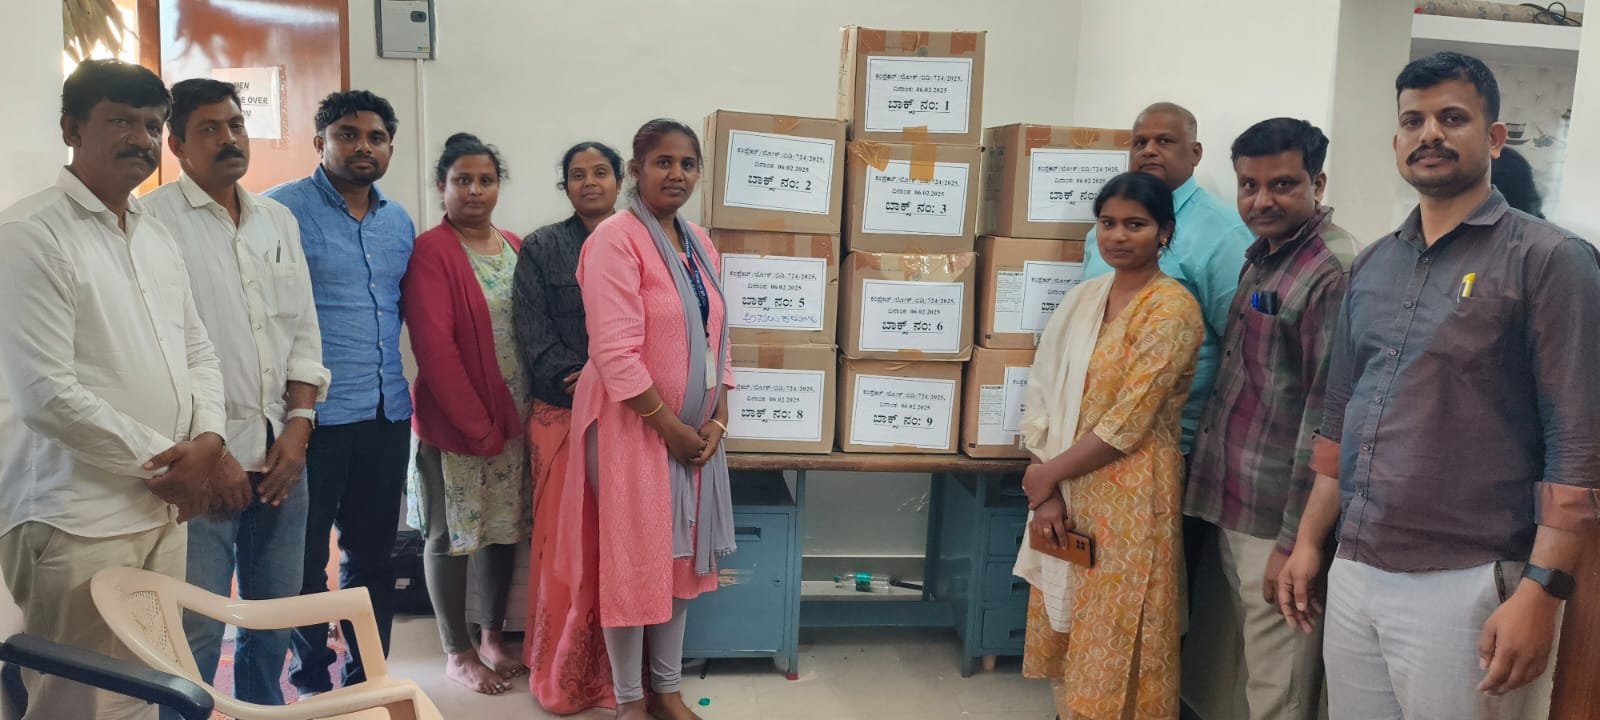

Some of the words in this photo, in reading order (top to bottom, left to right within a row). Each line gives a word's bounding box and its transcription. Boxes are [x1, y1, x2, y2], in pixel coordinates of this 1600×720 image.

[247, 96, 268, 104] OVER
[945, 100, 949, 110] 1
[805, 180, 812, 190] 2
[940, 204, 947, 214] 3
[798, 298, 805, 307] 5
[936, 322, 943, 331] 6
[796, 409, 803, 419] 8
[926, 417, 933, 426] 9
